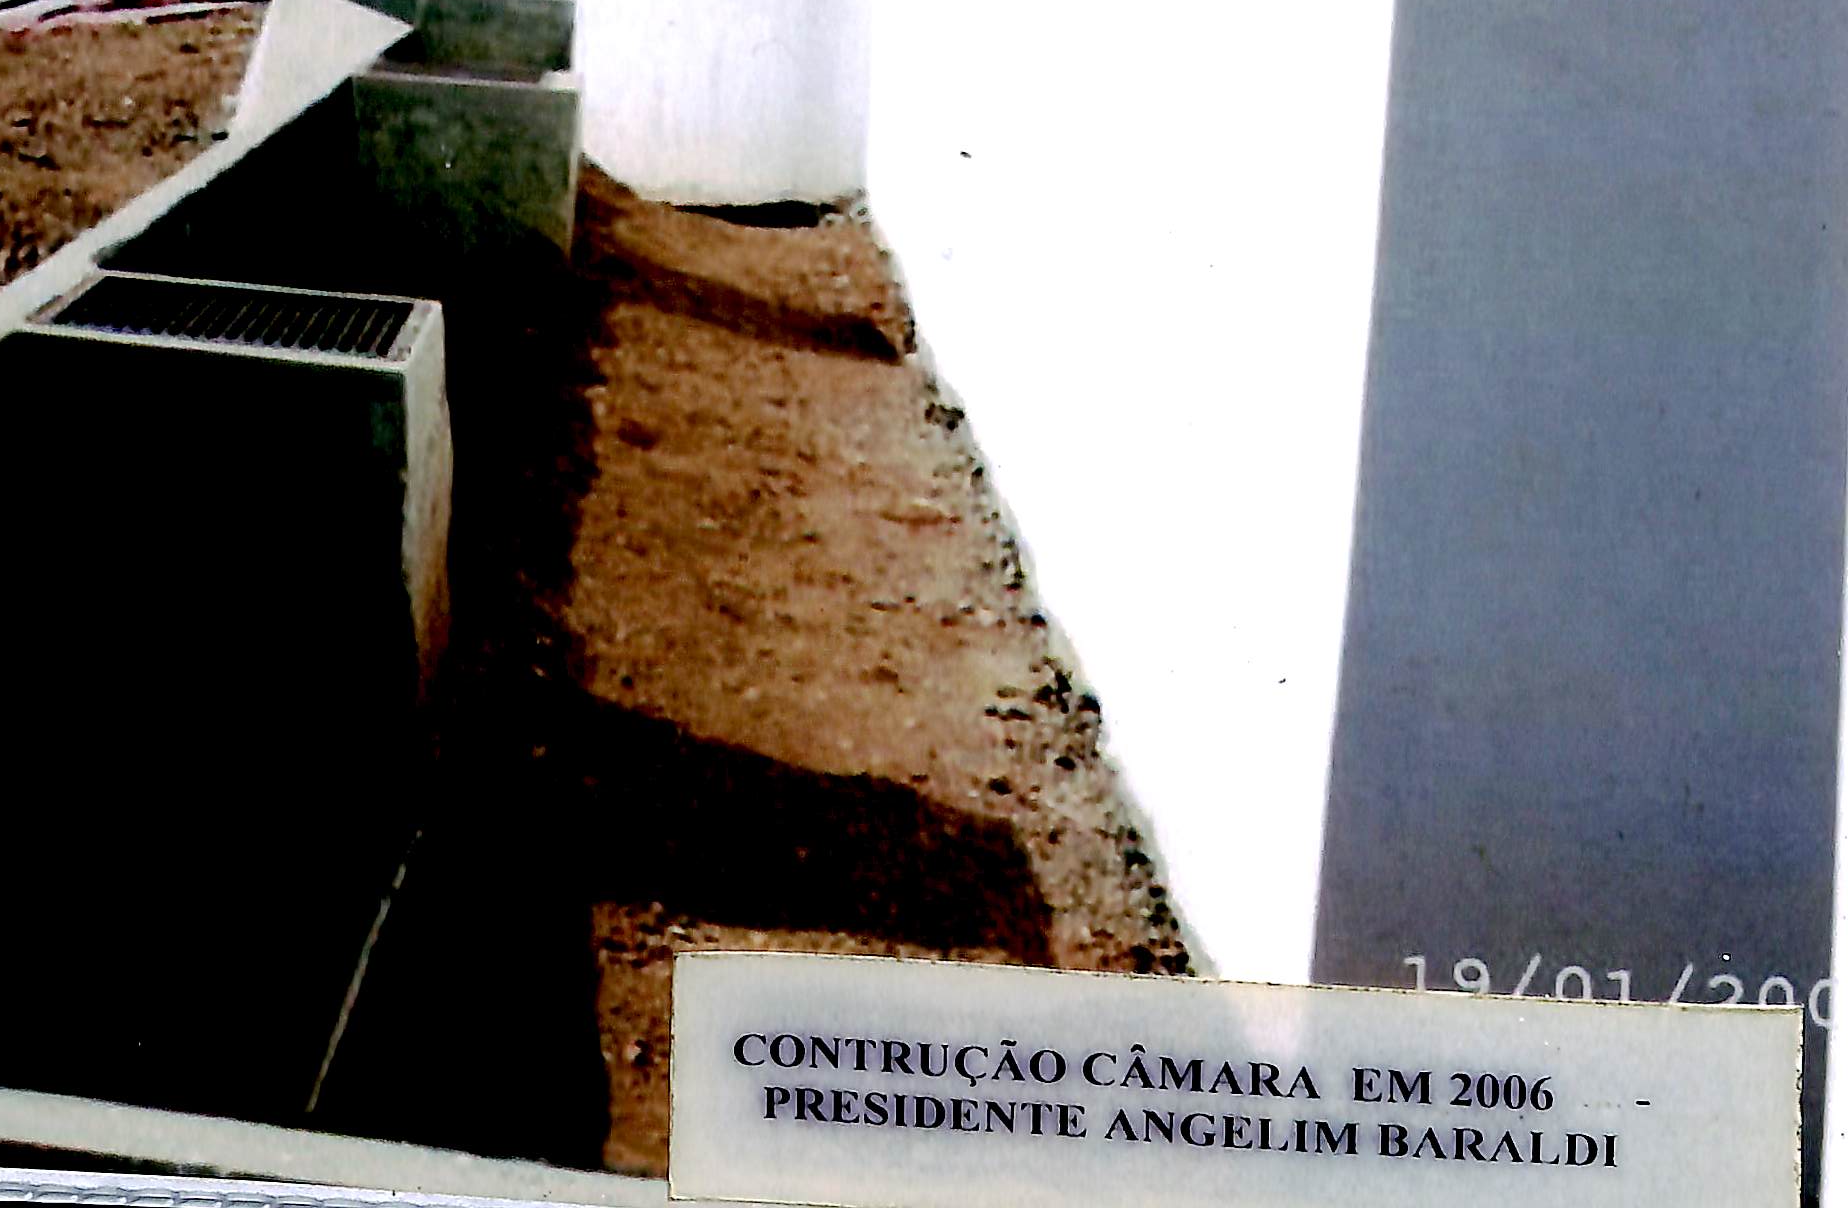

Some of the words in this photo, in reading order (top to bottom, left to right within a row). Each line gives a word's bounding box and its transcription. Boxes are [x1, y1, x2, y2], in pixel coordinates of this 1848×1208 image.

[733, 1033, 1068, 1088] CONTRUÇÃO
[1082, 1043, 1321, 1100] CÂMARA
[1352, 1067, 1433, 1105] EM
[1449, 1072, 1554, 1111] 2006
[763, 1086, 1087, 1139] PRESIDENTE
[1104, 1108, 1360, 1155] ANGELIM
[1377, 1123, 1618, 1168] BARALDI
